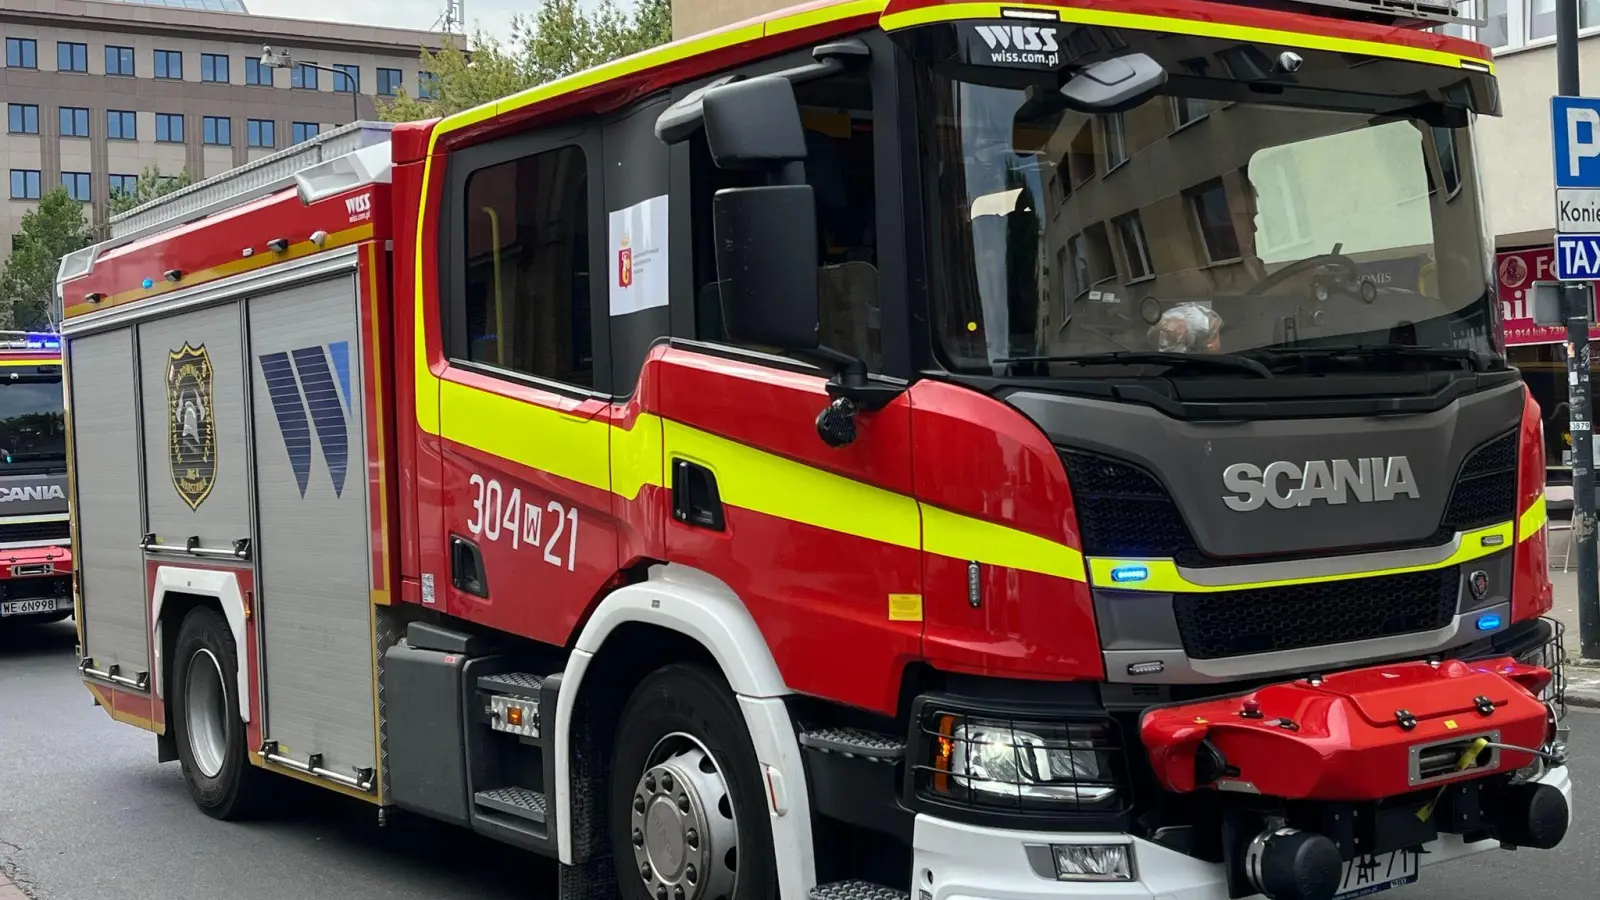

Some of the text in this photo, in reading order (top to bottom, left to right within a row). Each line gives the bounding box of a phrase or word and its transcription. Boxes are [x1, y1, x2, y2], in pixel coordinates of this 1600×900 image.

[974, 26, 1059, 52] WISS
[991, 50, 1059, 67] wiss.com.pl
[1566, 107, 1600, 176] P
[345, 193, 371, 215] WISS
[1222, 456, 1420, 512] SCANIA
[3, 600, 54, 614] WE 6N998
